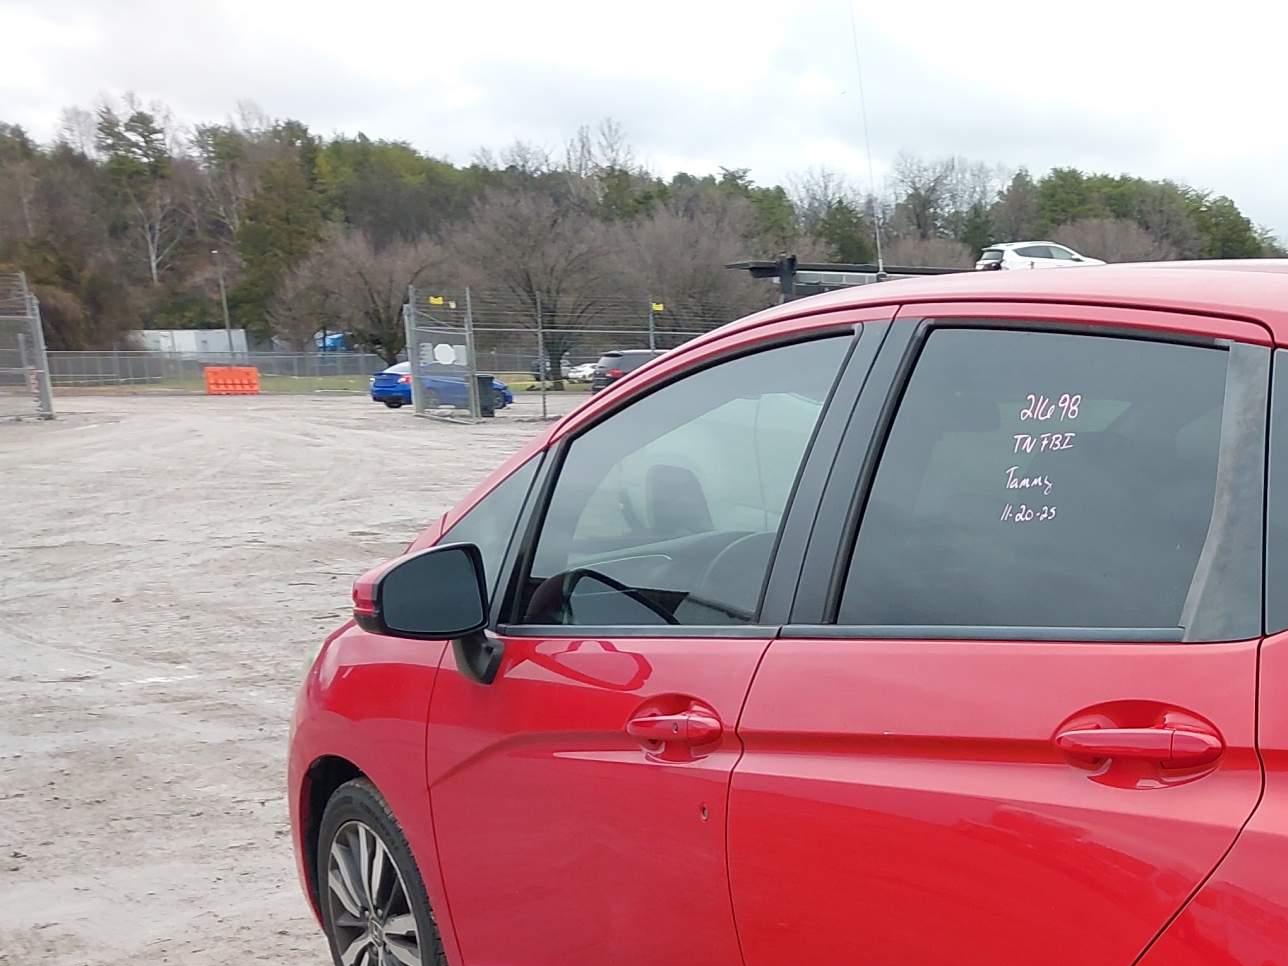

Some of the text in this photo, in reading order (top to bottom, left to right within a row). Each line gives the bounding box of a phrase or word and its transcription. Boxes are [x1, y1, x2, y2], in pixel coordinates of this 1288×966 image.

[1014, 432, 1076, 453] TN FBI
[1006, 466, 1052, 495] Tammy
